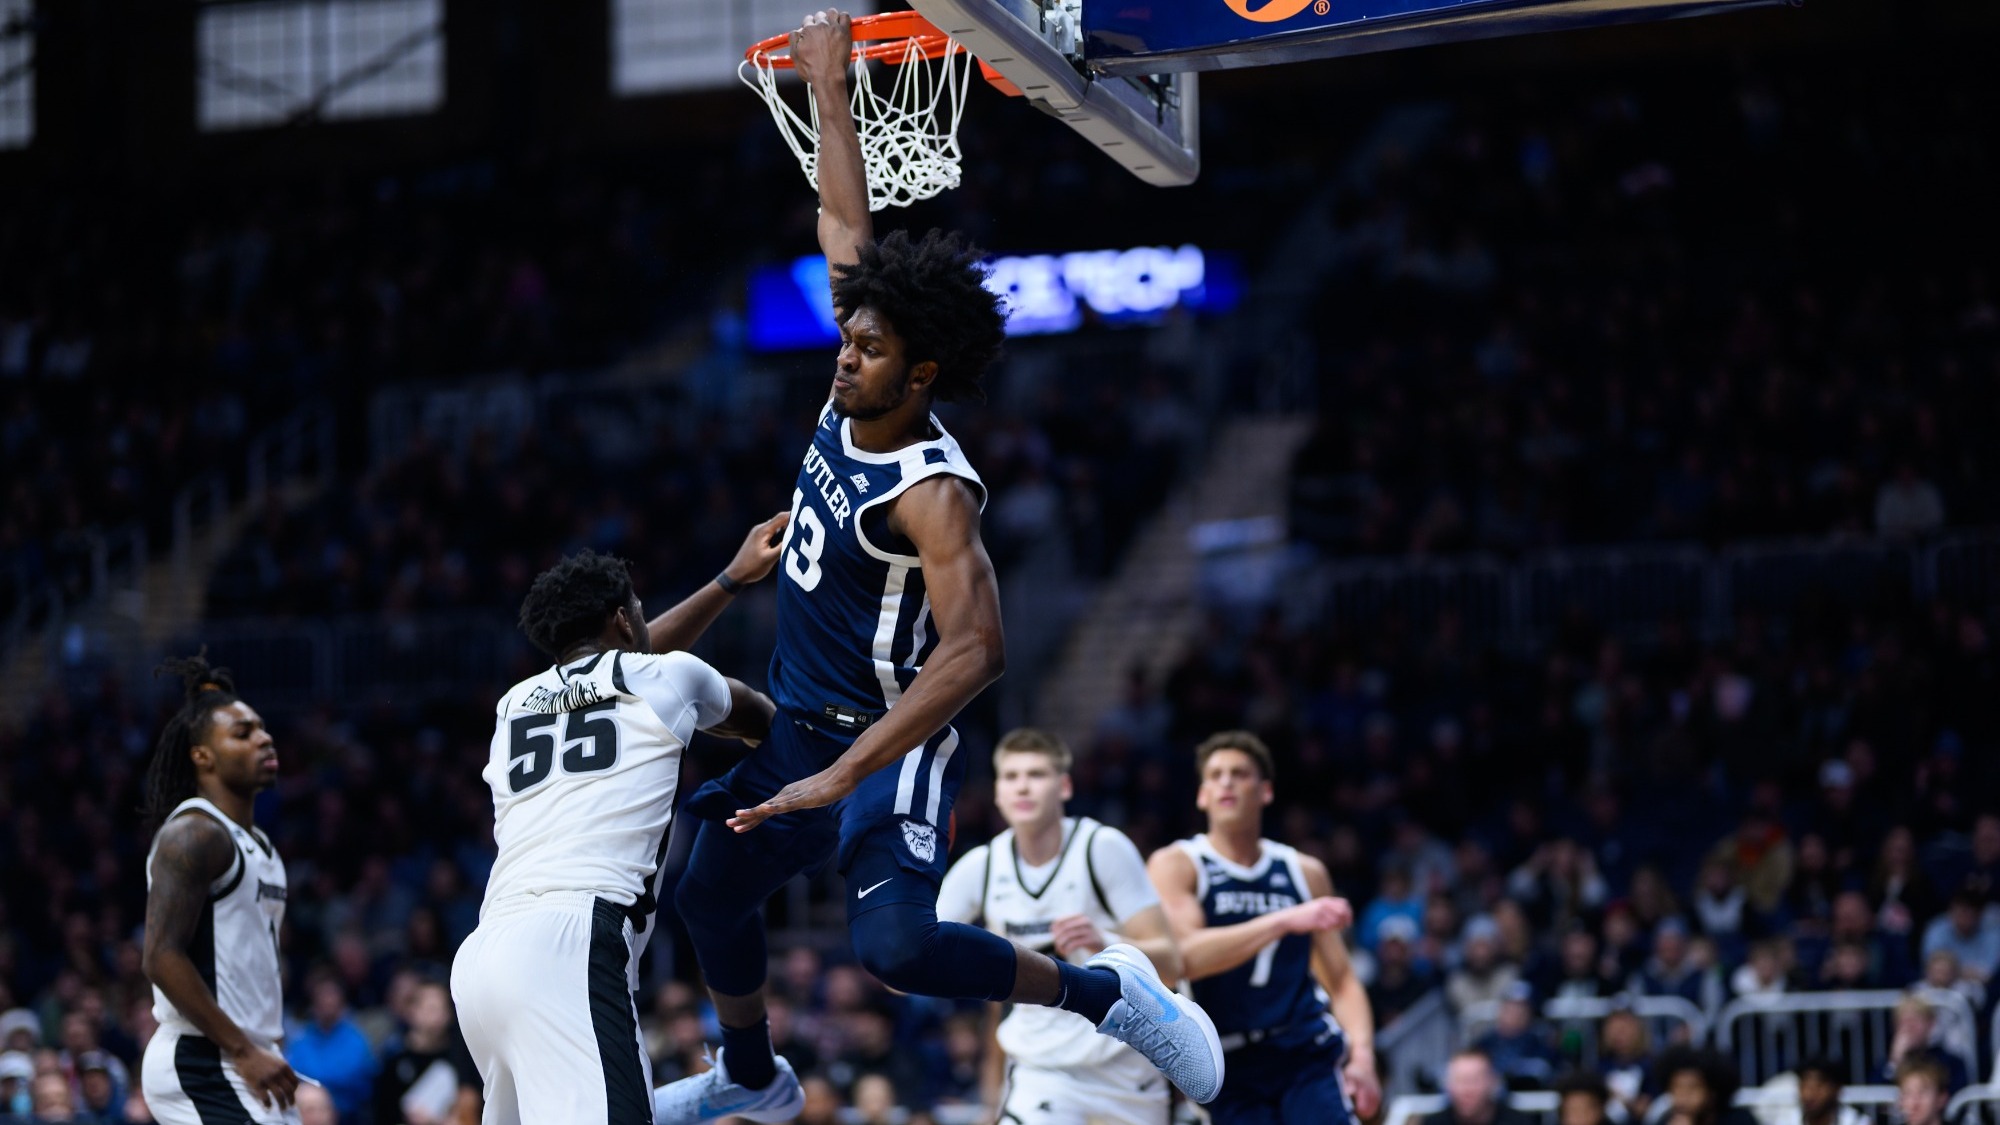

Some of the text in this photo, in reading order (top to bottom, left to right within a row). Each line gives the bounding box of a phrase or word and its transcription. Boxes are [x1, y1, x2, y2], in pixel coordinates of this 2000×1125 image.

[803, 443, 851, 530] BUTLER
[780, 487, 826, 593] 13
[507, 696, 621, 796] 55
